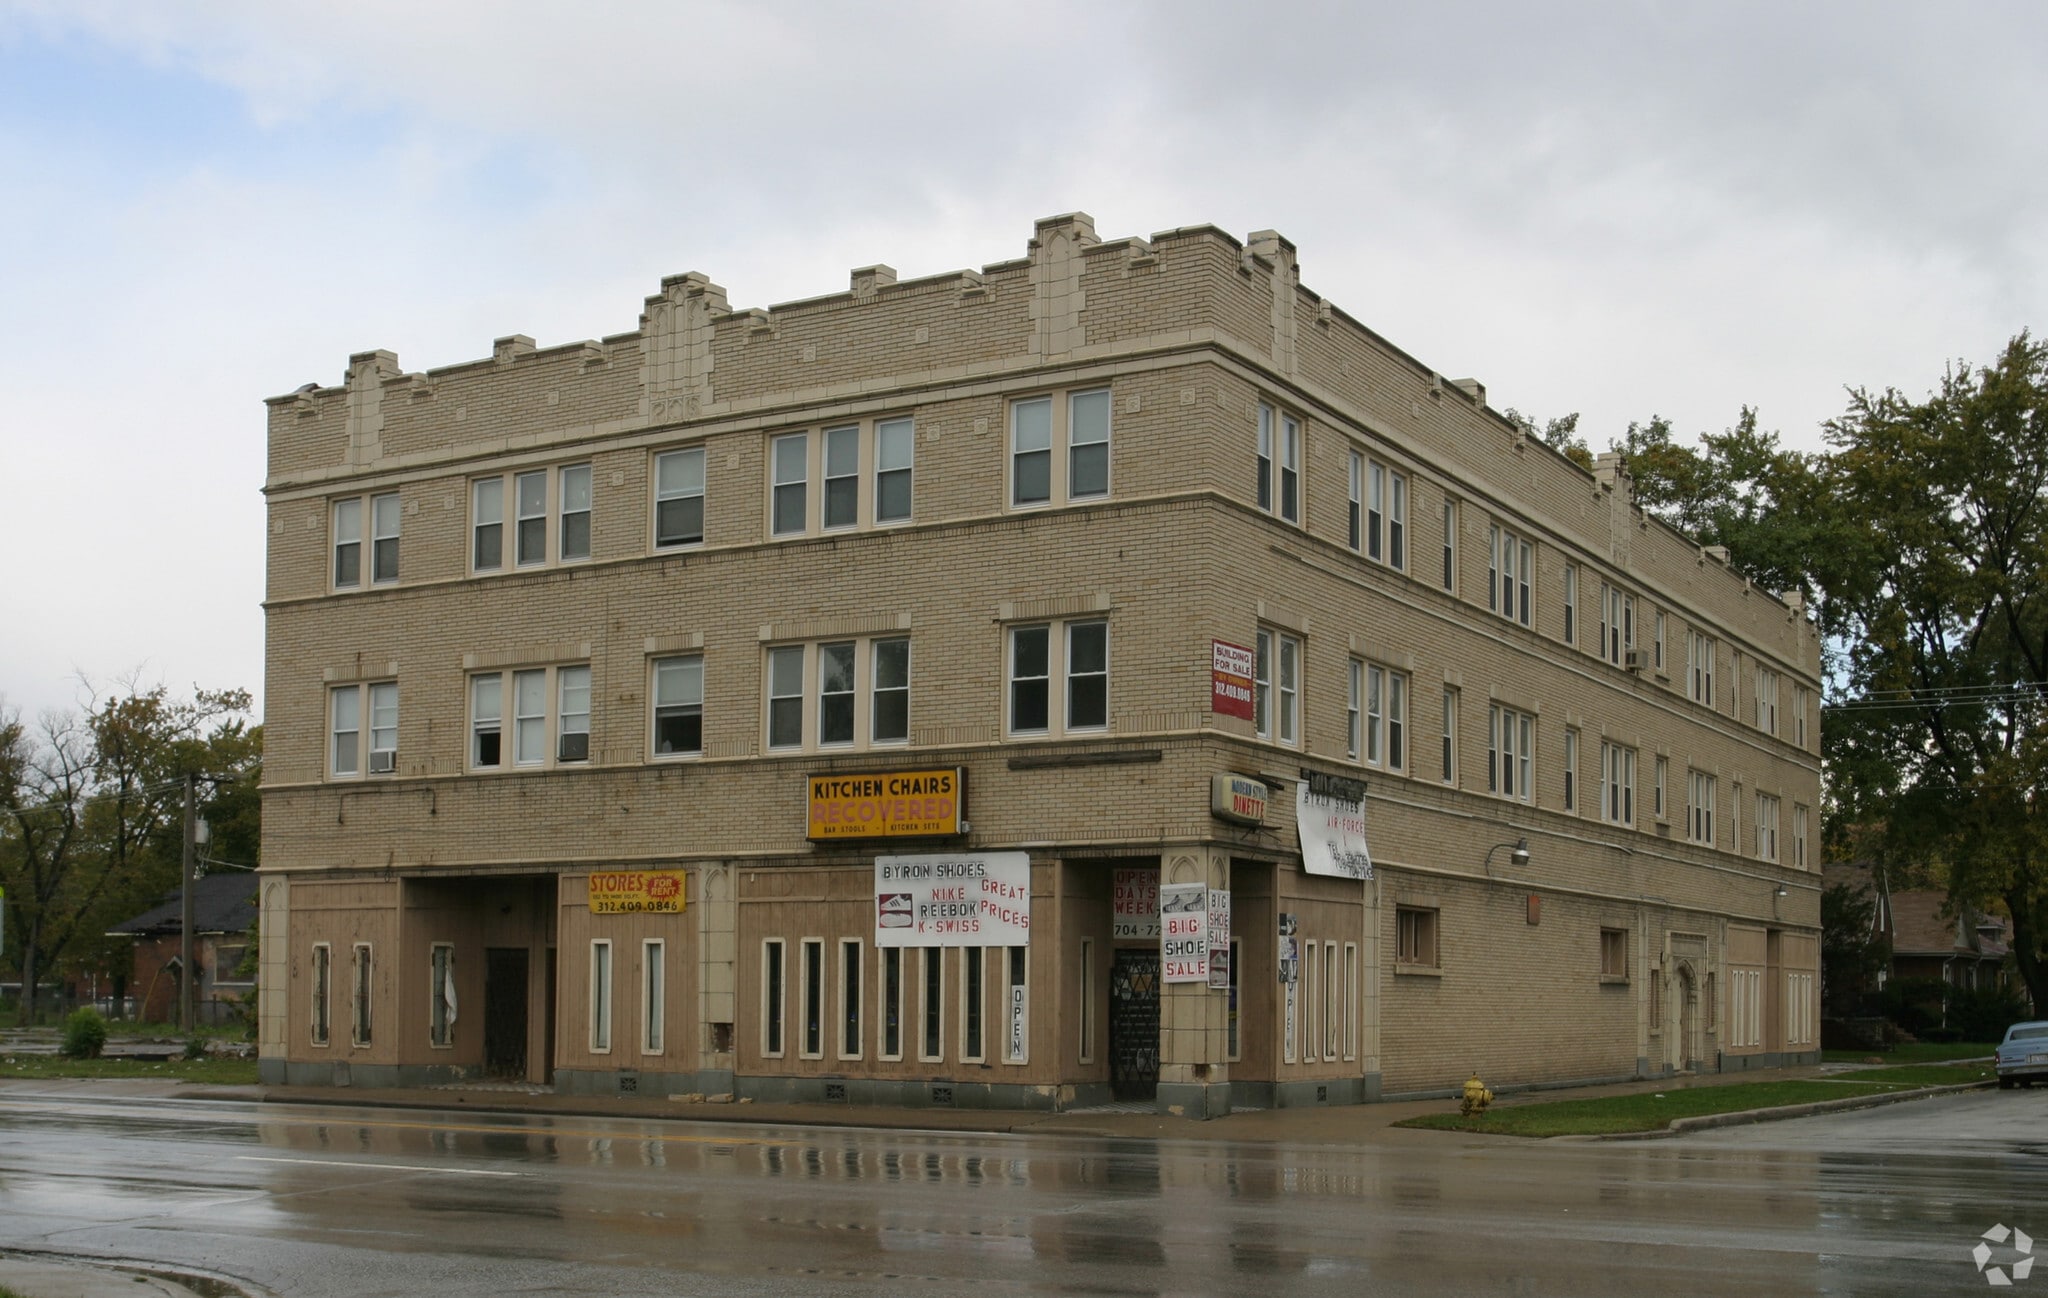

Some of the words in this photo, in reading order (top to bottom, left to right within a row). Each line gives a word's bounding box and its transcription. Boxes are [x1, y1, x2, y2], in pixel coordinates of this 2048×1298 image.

[1217, 647, 1249, 663] BUILDING
[1215, 659, 1230, 670] FOR
[1233, 663, 1250, 676] SALE
[814, 780, 883, 798] KITCHEN
[889, 776, 951, 795] CHAIRS
[813, 798, 953, 824] RECOVERED
[1234, 794, 1264, 818] DINETTE
[824, 826, 836, 834] BAR
[923, 822, 940, 830] SETS
[1328, 816, 1363, 834] AIR-FORCE
[884, 865, 930, 879] BYRON
[936, 863, 985, 876] SHOES
[1116, 871, 1158, 884] OPEN
[591, 874, 644, 892] STORES
[654, 878, 672, 887] FOR
[982, 879, 1025, 900] GREAT
[651, 887, 676, 896] RENT
[932, 888, 964, 900] NIKE
[1116, 886, 1156, 899] DAYS
[598, 902, 678, 912] 312.409.0846
[1116, 902, 1153, 914] WEEK
[1212, 894, 1226, 908] BIG
[920, 903, 976, 918] REEBOK
[980, 900, 1028, 928] PRICES
[1169, 919, 1198, 934] BIG
[1210, 912, 1228, 928] SHOE
[1210, 930, 1228, 944] SALE
[1166, 940, 1204, 956] SHOE
[1166, 961, 1205, 976] SALE
